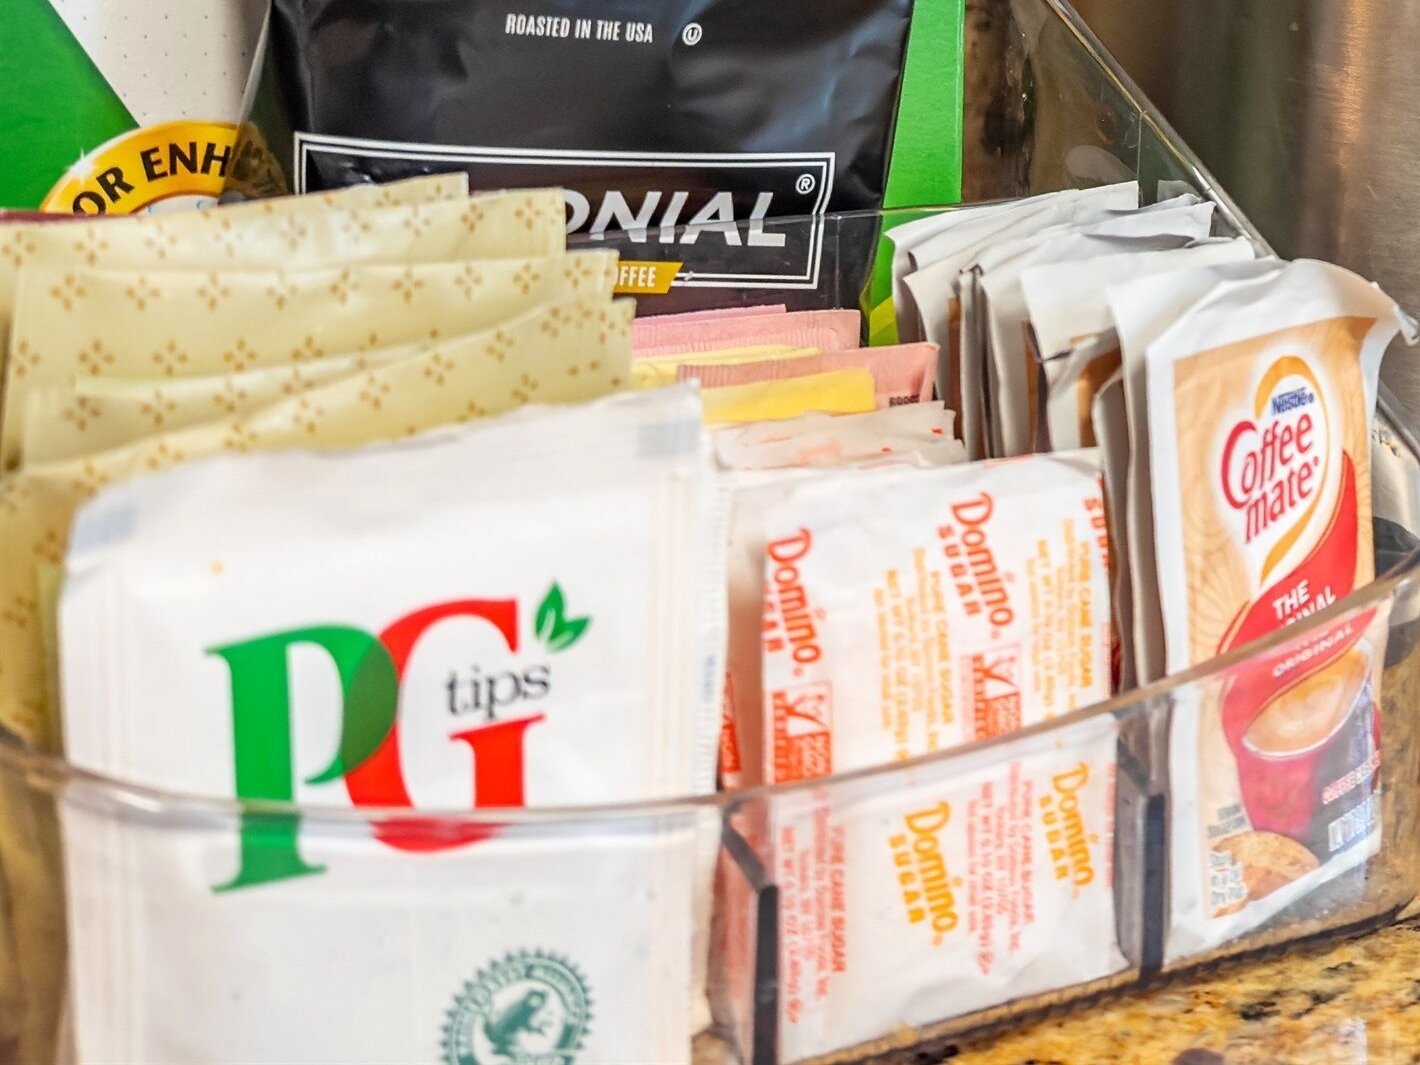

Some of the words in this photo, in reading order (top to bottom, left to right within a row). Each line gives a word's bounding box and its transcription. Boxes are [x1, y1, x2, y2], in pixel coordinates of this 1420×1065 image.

[505, 13, 571, 38] ROASTED
[575, 19, 591, 39] IN
[596, 20, 620, 41] THE
[625, 22, 653, 43] USA
[140, 141, 232, 182] ENH
[617, 266, 656, 287] FFEE
[1221, 413, 1313, 510] Coffee
[1245, 461, 1313, 544] mate
[767, 526, 822, 664] Domino
[938, 525, 983, 617] SUGAR
[950, 491, 1015, 626] Domino
[1271, 578, 1310, 620] THE
[203, 597, 547, 895] PG
[445, 663, 552, 721] tips
[903, 800, 958, 934] Domino
[1038, 794, 1070, 881] SUGAR
[1051, 761, 1095, 886] Domino
[888, 833, 926, 925] SUGAR
